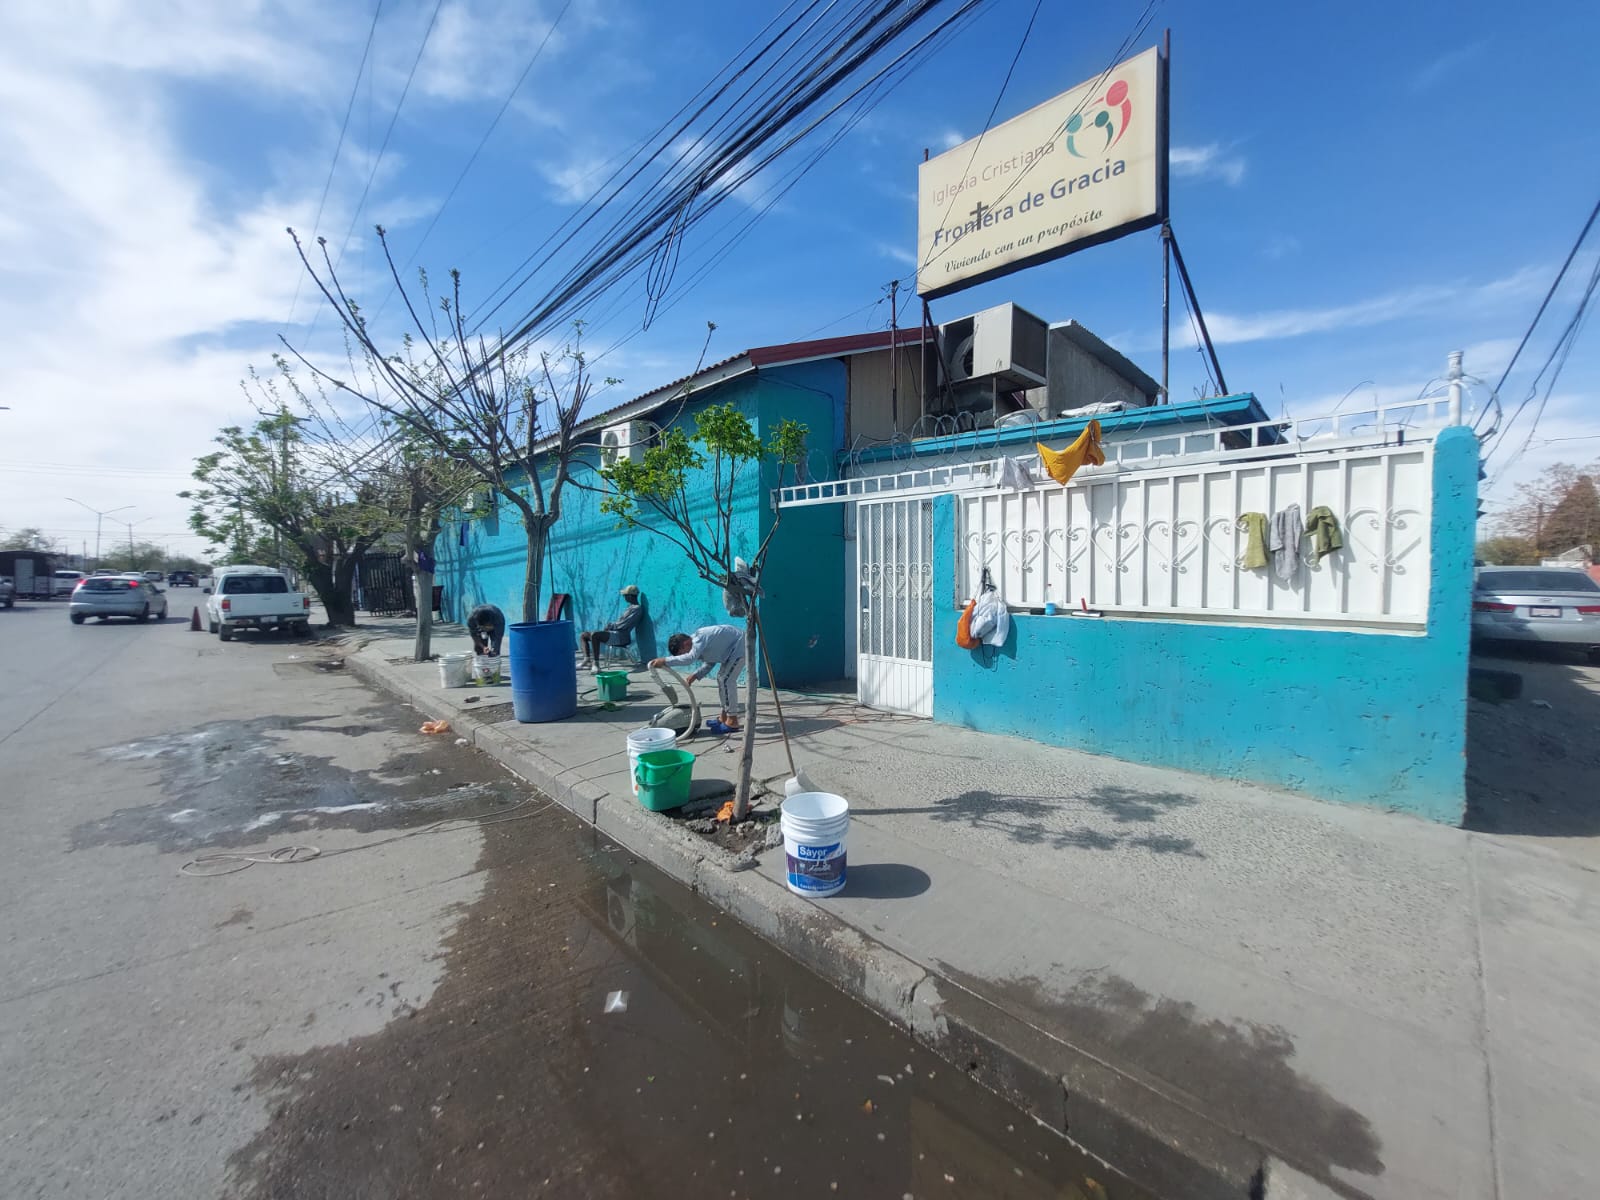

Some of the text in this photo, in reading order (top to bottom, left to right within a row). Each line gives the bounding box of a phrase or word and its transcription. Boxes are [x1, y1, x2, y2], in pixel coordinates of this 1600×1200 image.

[933, 140, 1055, 205] Iglesia Cristiana
[934, 158, 1126, 247] Frontera de Gracia
[945, 209, 1103, 272] Viviendo con un propósito
[799, 846, 826, 858] Sayer
